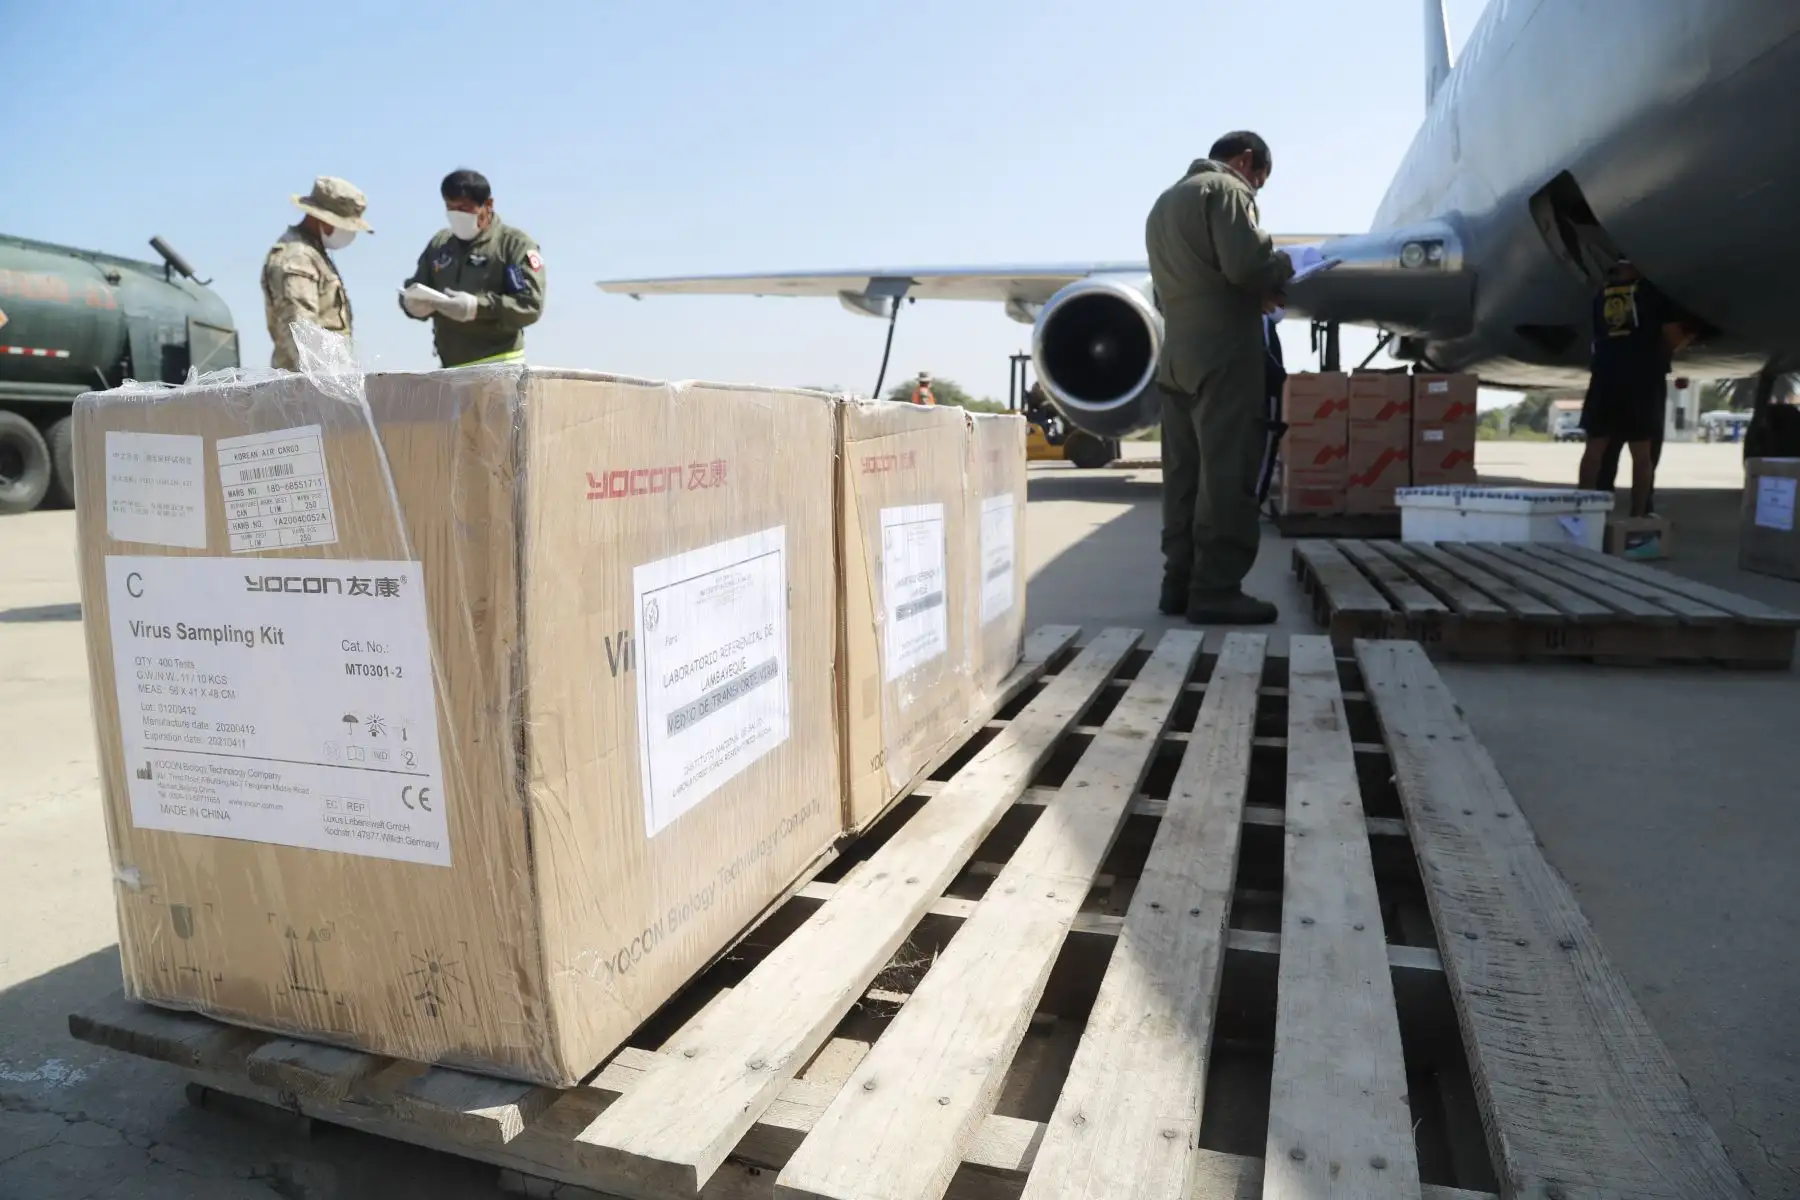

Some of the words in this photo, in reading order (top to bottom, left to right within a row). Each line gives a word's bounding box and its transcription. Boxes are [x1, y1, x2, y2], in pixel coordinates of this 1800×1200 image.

[233, 450, 258, 460] KOREAN
[262, 448, 274, 457] AIR
[278, 444, 300, 454] CARGO
[126, 572, 144, 598] C
[129, 620, 172, 640] Virus
[176, 622, 254, 648] Sampling
[260, 626, 285, 646] Kit
[341, 640, 364, 654] Cat.
[158, 657, 174, 668] 400
[174, 658, 195, 669] Tests
[662, 650, 718, 689] LABORATORIO
[764, 623, 774, 638] DE
[208, 674, 228, 685] KGS
[345, 663, 403, 679] MT0301-2
[188, 688, 198, 698] 41
[220, 689, 236, 700] CM
[699, 698, 709, 716] DE
[142, 714, 190, 729] Manufacture
[216, 722, 256, 735] 20200412
[144, 730, 183, 742] Expiration
[207, 736, 246, 749] 20210411
[247, 768, 281, 782] Company
[160, 804, 188, 816] MADE
[190, 806, 200, 818] IN
[201, 808, 232, 822] CHINA
[346, 802, 366, 812] REP
[668, 880, 716, 934] Biology
[717, 833, 778, 888] Technology
[780, 798, 820, 839] Company
